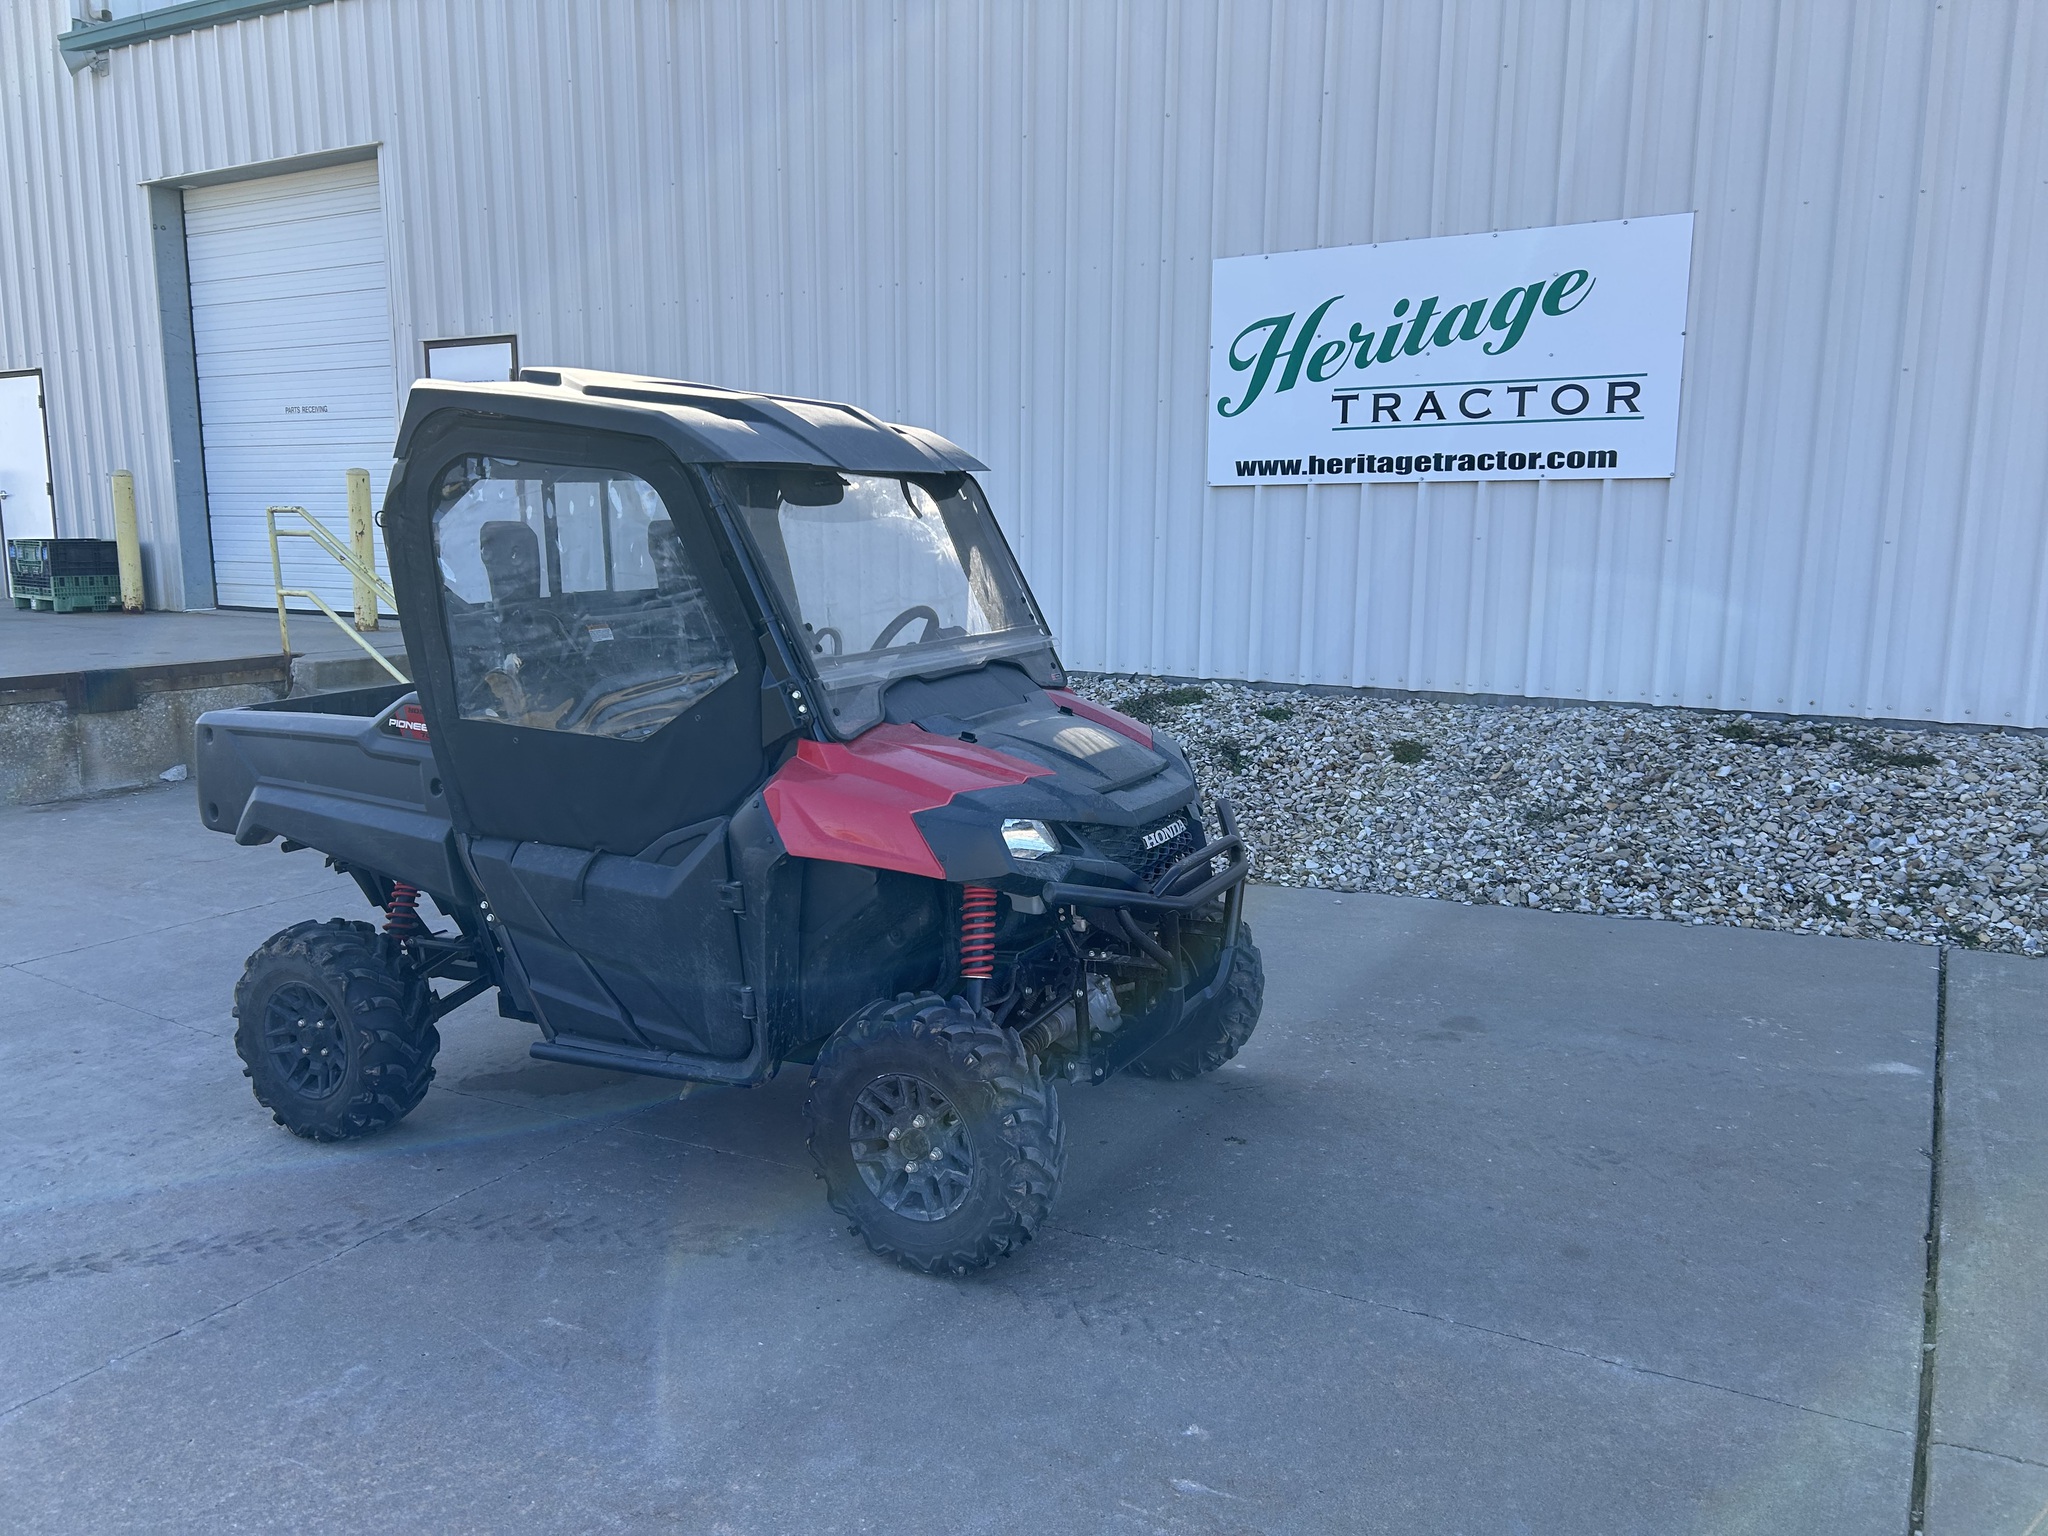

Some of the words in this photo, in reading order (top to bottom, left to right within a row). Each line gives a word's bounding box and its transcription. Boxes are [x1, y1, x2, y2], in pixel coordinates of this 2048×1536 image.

[1217, 269, 1596, 418] Heritage
[285, 406, 301, 415] PARTS
[302, 405, 328, 414] RECEIVING
[1331, 381, 1642, 424] TRACTOR
[1235, 448, 1618, 477] www.heritagetractor.com
[389, 718, 428, 732] PIONEE
[1142, 819, 1187, 850] HONDA
